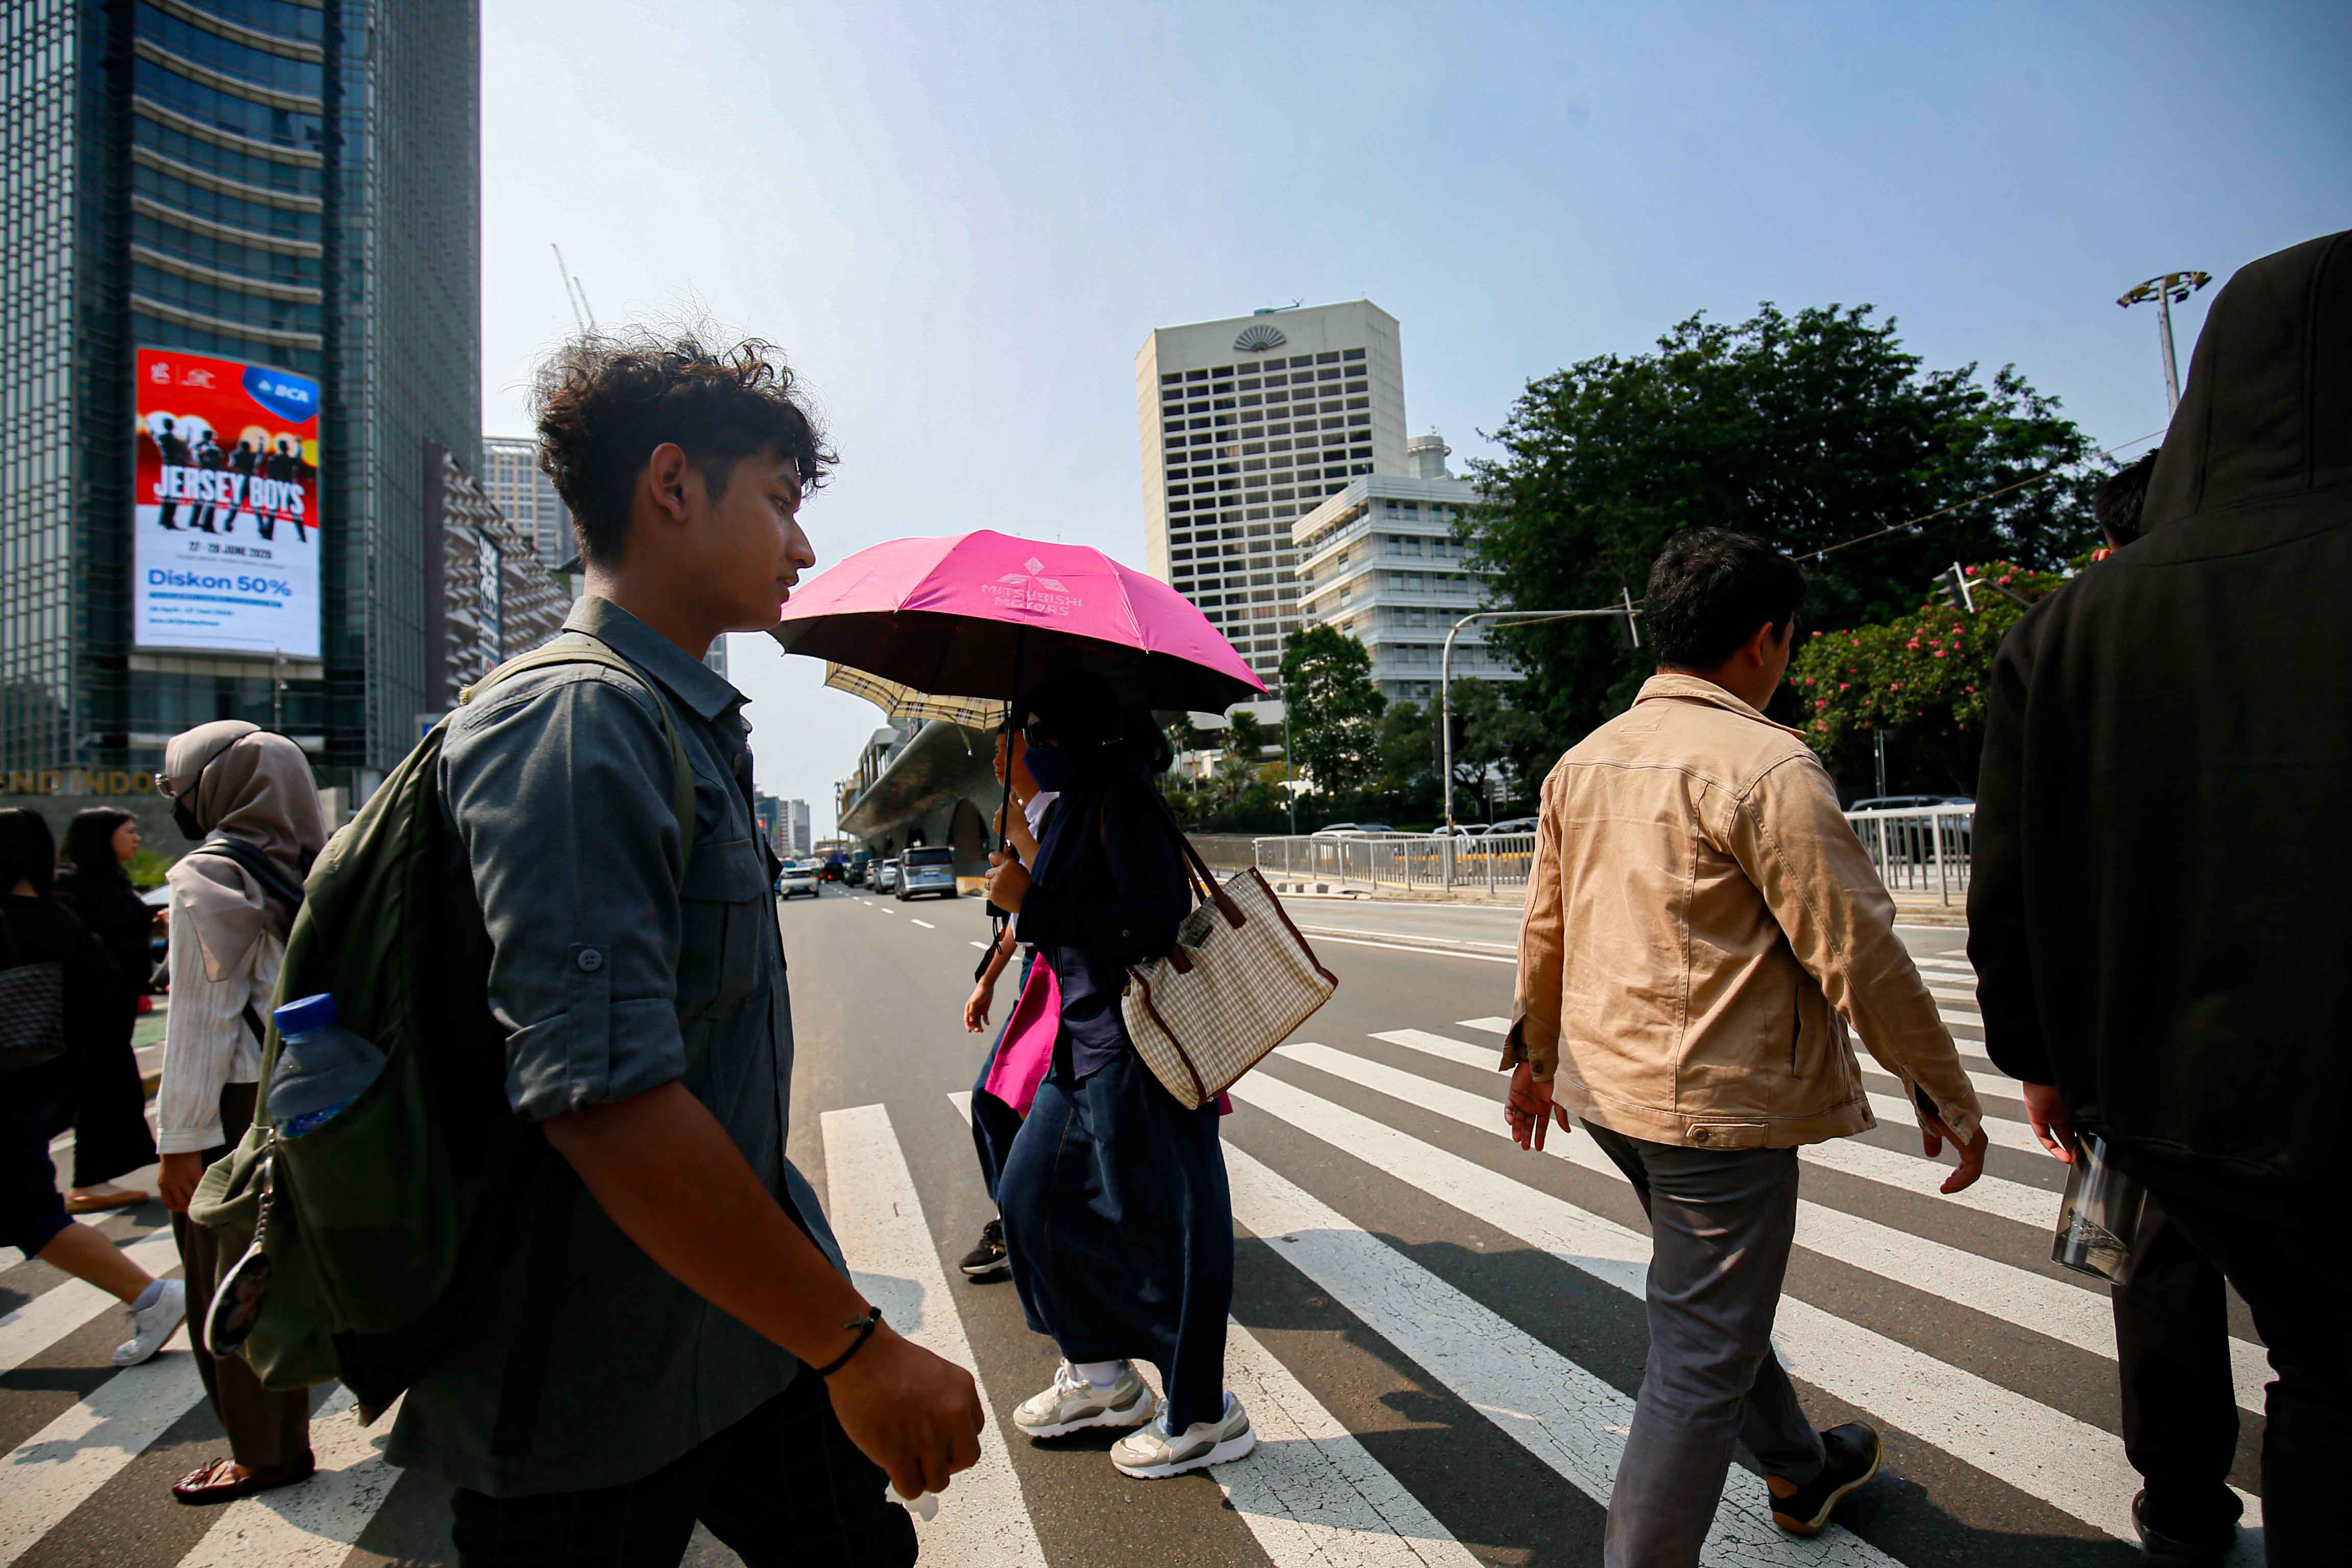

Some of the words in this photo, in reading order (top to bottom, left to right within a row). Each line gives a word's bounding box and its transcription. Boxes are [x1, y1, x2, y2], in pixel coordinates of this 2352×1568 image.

[274, 384, 309, 403] BCA
[153, 464, 244, 503] JERSEY
[249, 475, 305, 515] BOYS
[224, 545, 246, 555] JUNE
[149, 569, 231, 590] Diskon
[237, 576, 292, 597] 50%
[982, 584, 1083, 607] MITSUBISHI
[994, 597, 1069, 616] MOTORS
